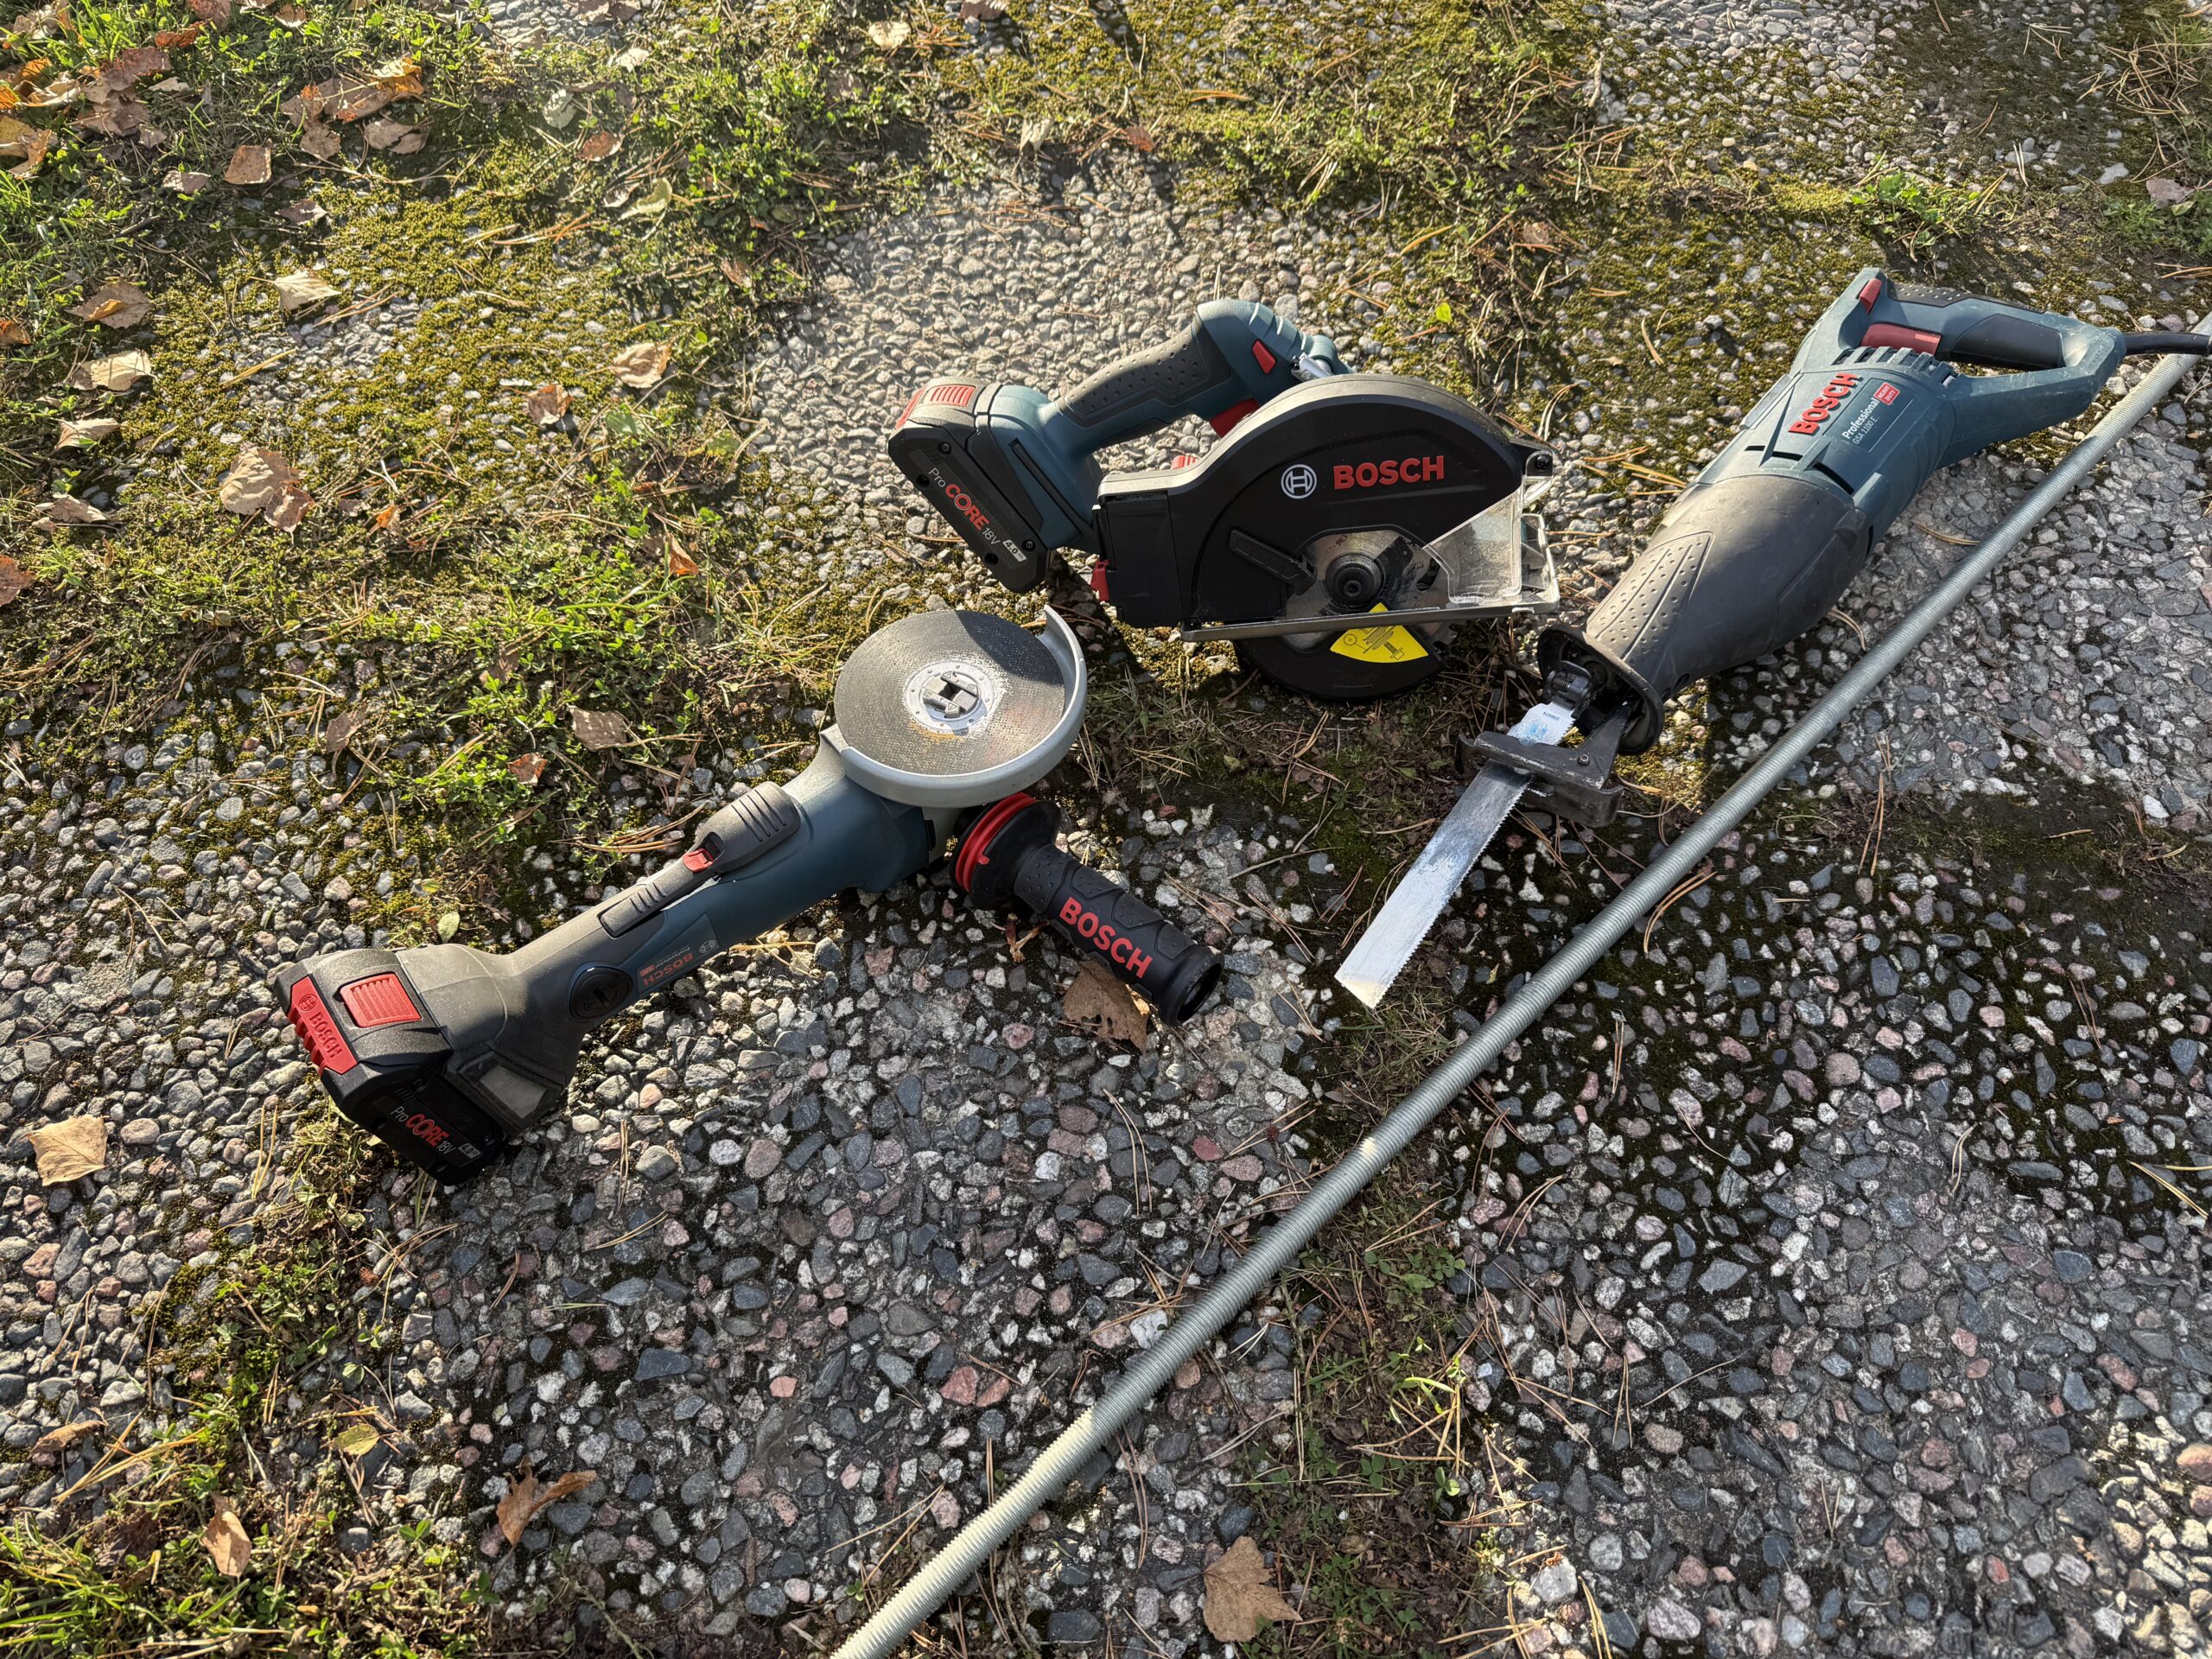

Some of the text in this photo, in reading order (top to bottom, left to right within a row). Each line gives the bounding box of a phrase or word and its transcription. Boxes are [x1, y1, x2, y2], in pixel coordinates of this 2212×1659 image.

[1788, 372, 1859, 434] BOSCH
[1841, 397, 1880, 440] Professional
[1853, 433, 1865, 444] GSA
[1861, 420, 1874, 435] 1100
[1333, 455, 1445, 490] BOSCH
[1005, 540, 1019, 555] 4.0
[1059, 897, 1154, 979] BOSCH
[642, 953, 694, 987] BOSCH
[309, 1012, 343, 1058] BOSCH
[461, 1144, 474, 1154] 4.0
